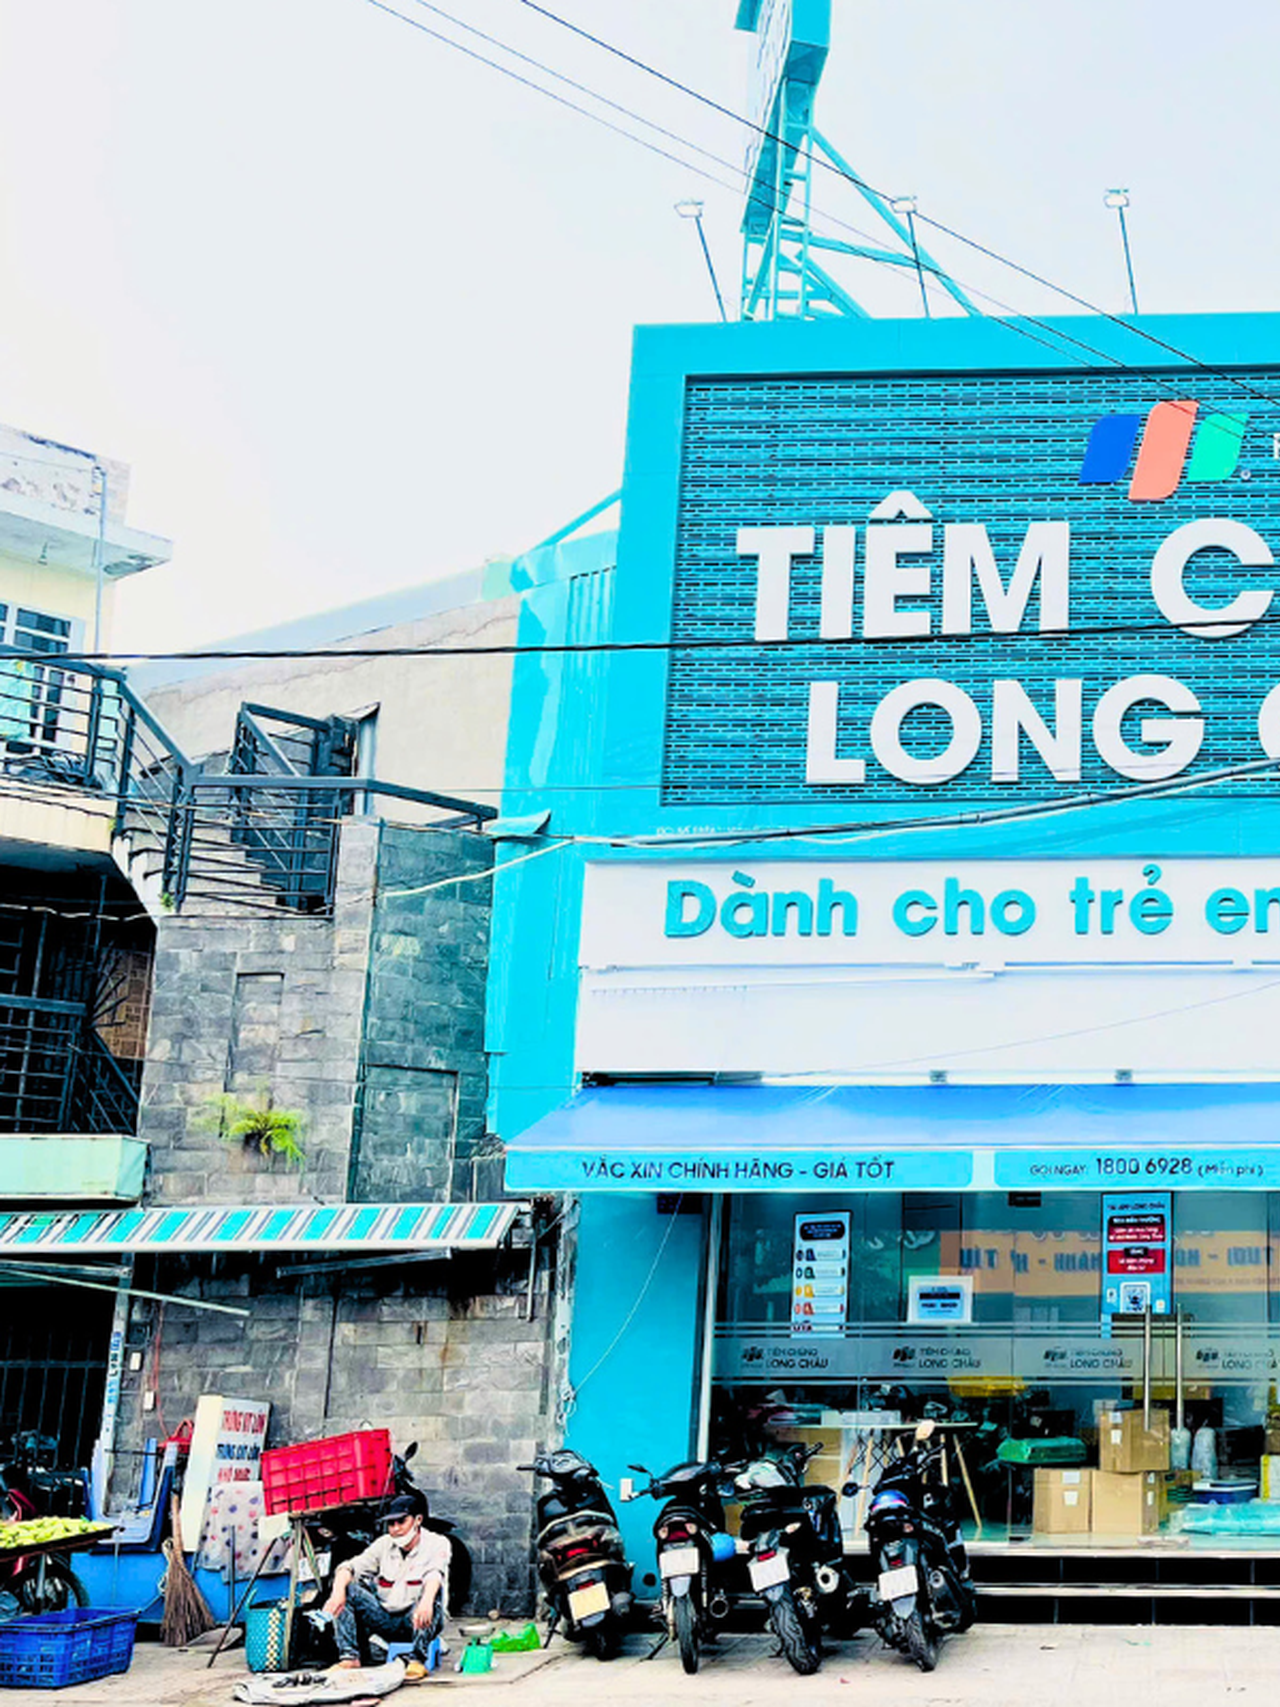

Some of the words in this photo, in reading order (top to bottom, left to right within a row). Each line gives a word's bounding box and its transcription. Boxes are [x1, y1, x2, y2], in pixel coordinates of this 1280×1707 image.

[735, 489, 1070, 643] TIÊM
[805, 674, 1205, 786] LONG
[663, 869, 858, 939] Dành
[892, 877, 1037, 937] cho
[1069, 863, 1175, 936] trẻ
[630, 1162, 663, 1179] XIN
[667, 1157, 729, 1179] CHÍNH
[812, 1156, 848, 1179] GIÁ
[855, 1154, 895, 1179] TỐT
[1096, 1158, 1140, 1175] 1800
[1145, 1158, 1194, 1175] 6928
